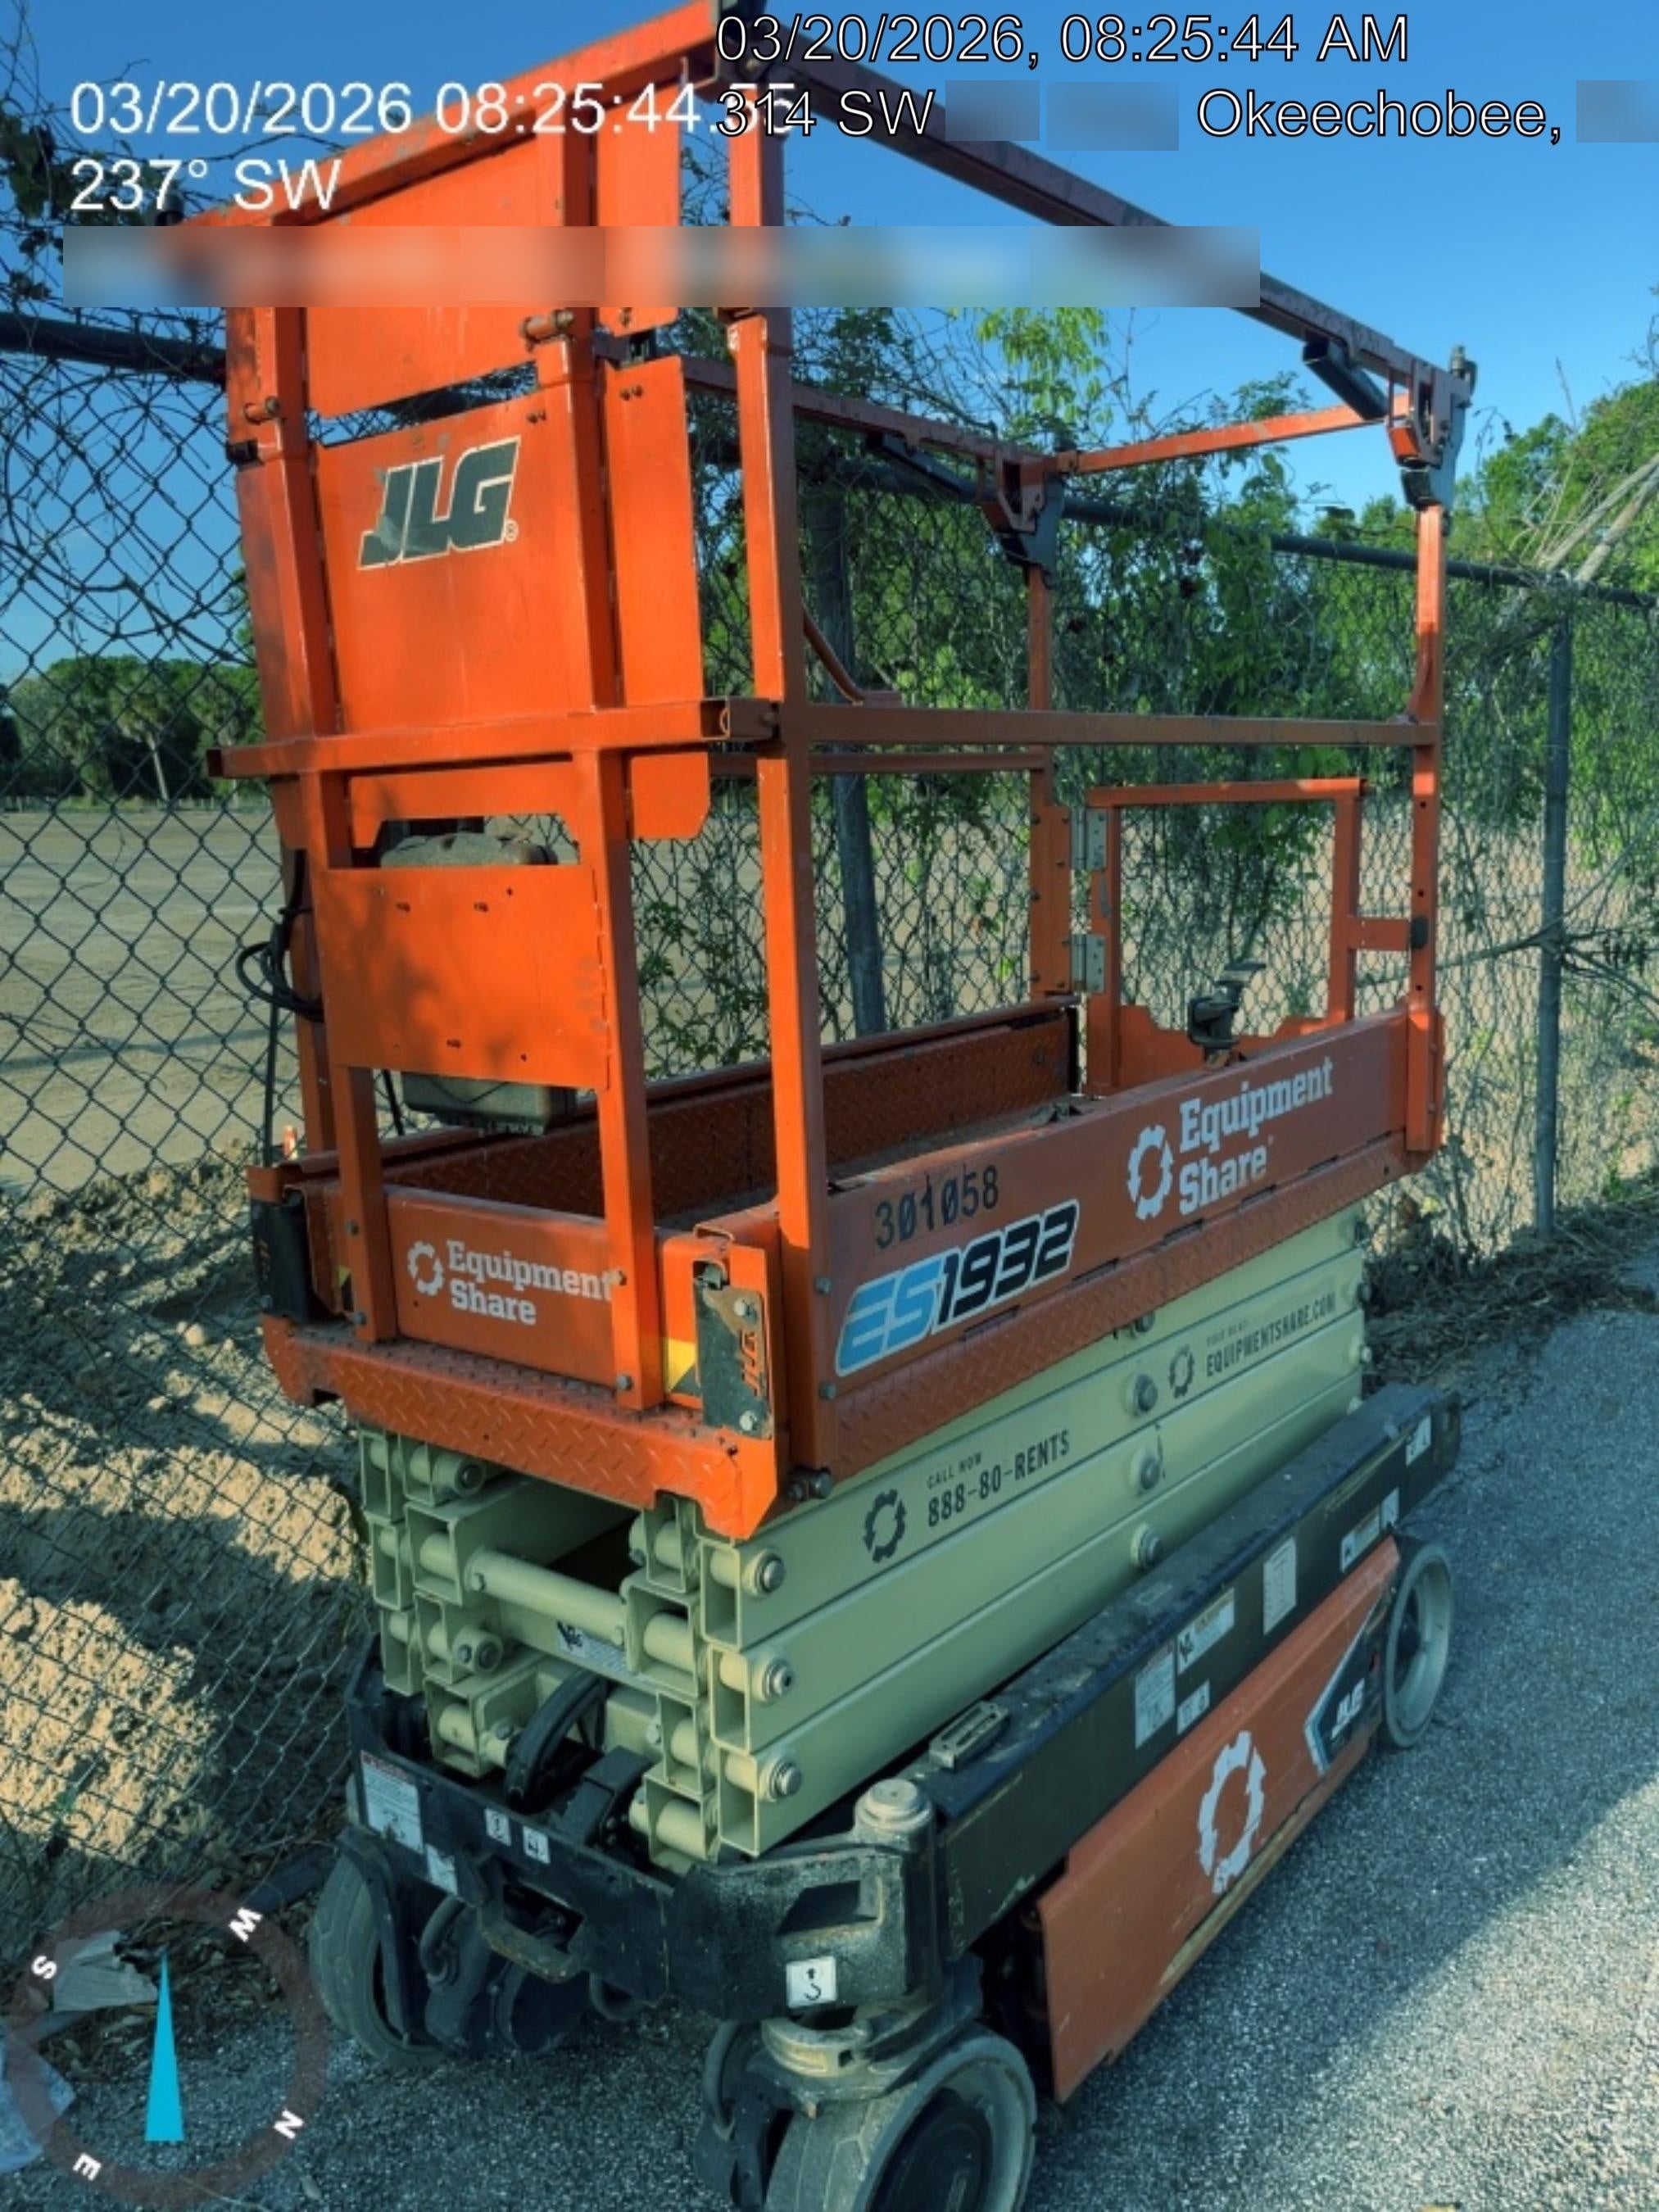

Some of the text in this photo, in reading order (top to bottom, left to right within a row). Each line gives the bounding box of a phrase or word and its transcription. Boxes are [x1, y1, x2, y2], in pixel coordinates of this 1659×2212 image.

[356, 435, 522, 571] JLG
[1179, 1056, 1333, 1154] Equipment
[874, 1164, 999, 1249] 301058
[1179, 1145, 1268, 1216] Share
[450, 1278, 537, 1326] Share
[835, 1199, 1080, 1377] ES1932
[1205, 1291, 1337, 1378] EQUIPMENTSHARE.COM
[927, 1465, 955, 1489] CALL
[927, 1430, 1071, 1527] 888-80-RENTS
